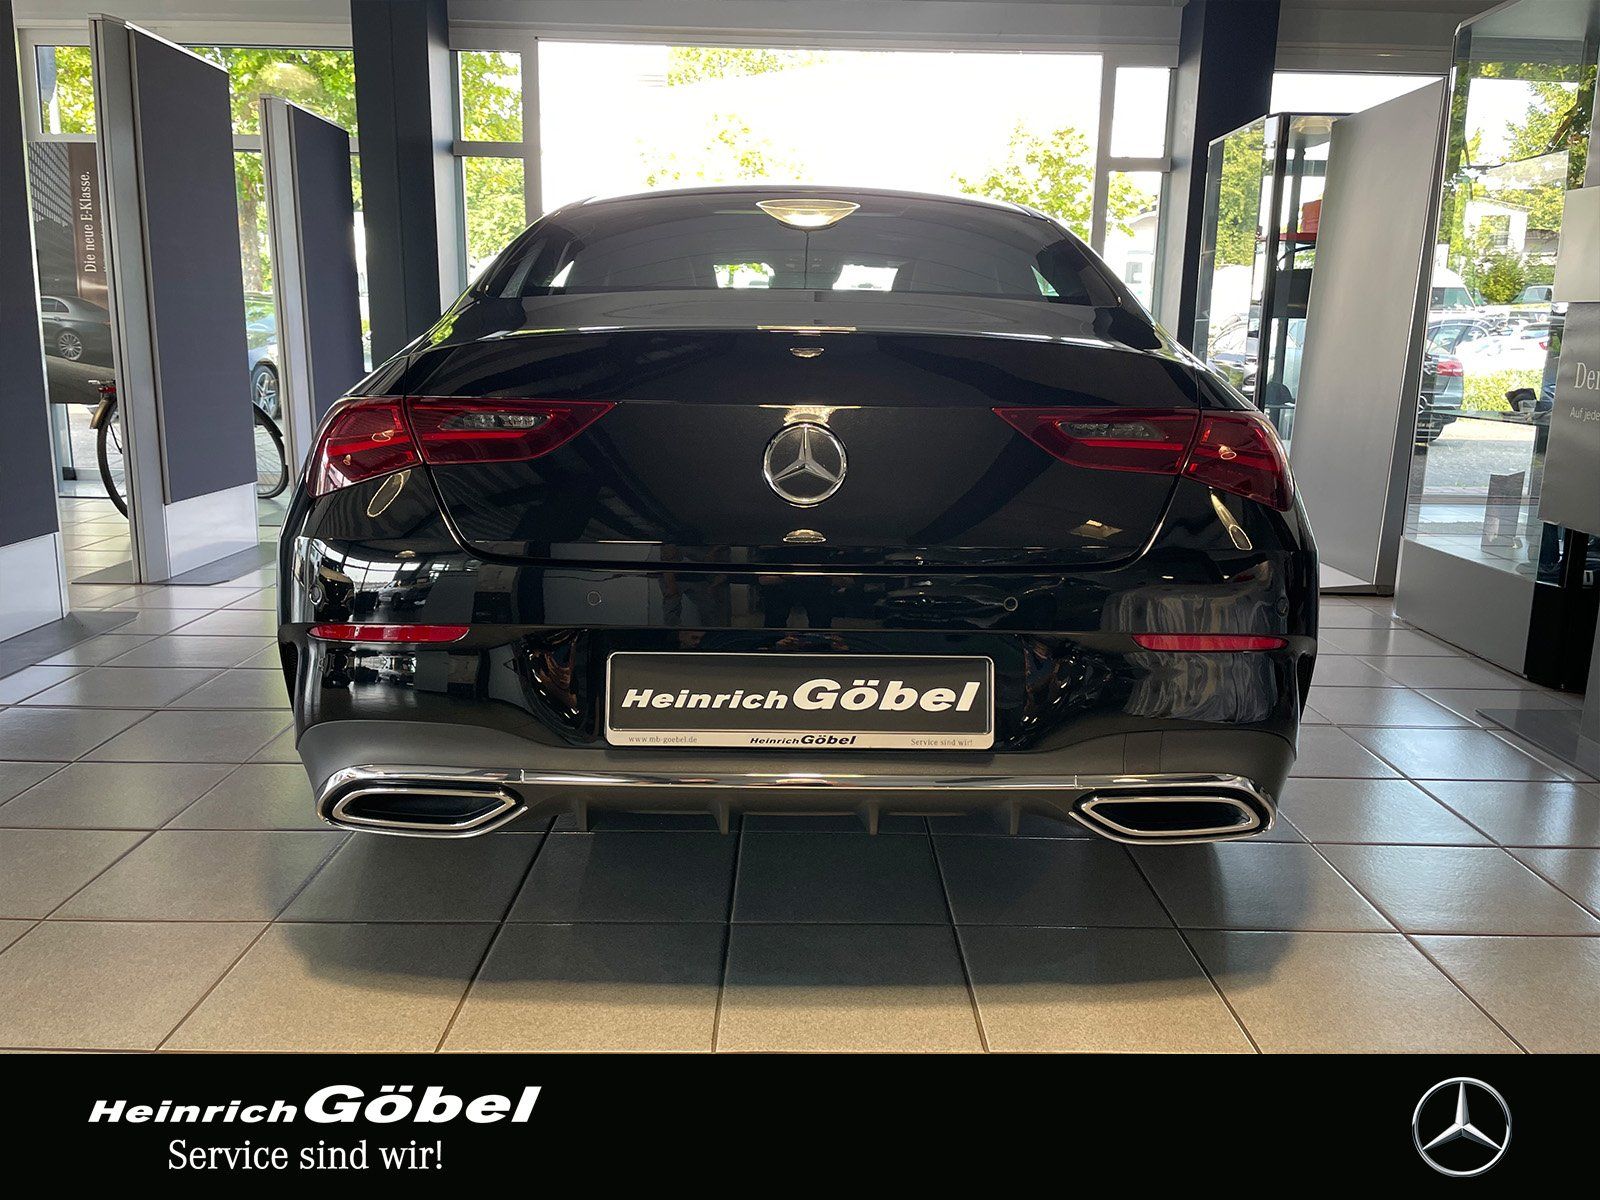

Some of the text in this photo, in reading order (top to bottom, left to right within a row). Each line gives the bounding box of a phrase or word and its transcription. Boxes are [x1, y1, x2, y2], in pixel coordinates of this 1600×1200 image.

[79, 171, 97, 273] Die neue E-Klasse.
[1569, 406, 1583, 419] Auf
[621, 678, 981, 712] Heinrich Göbel
[628, 735, 698, 744] www.mb-goebel.de
[749, 734, 857, 745] Heinrich Göbel
[910, 738, 938, 746] Service
[940, 738, 956, 746] sind
